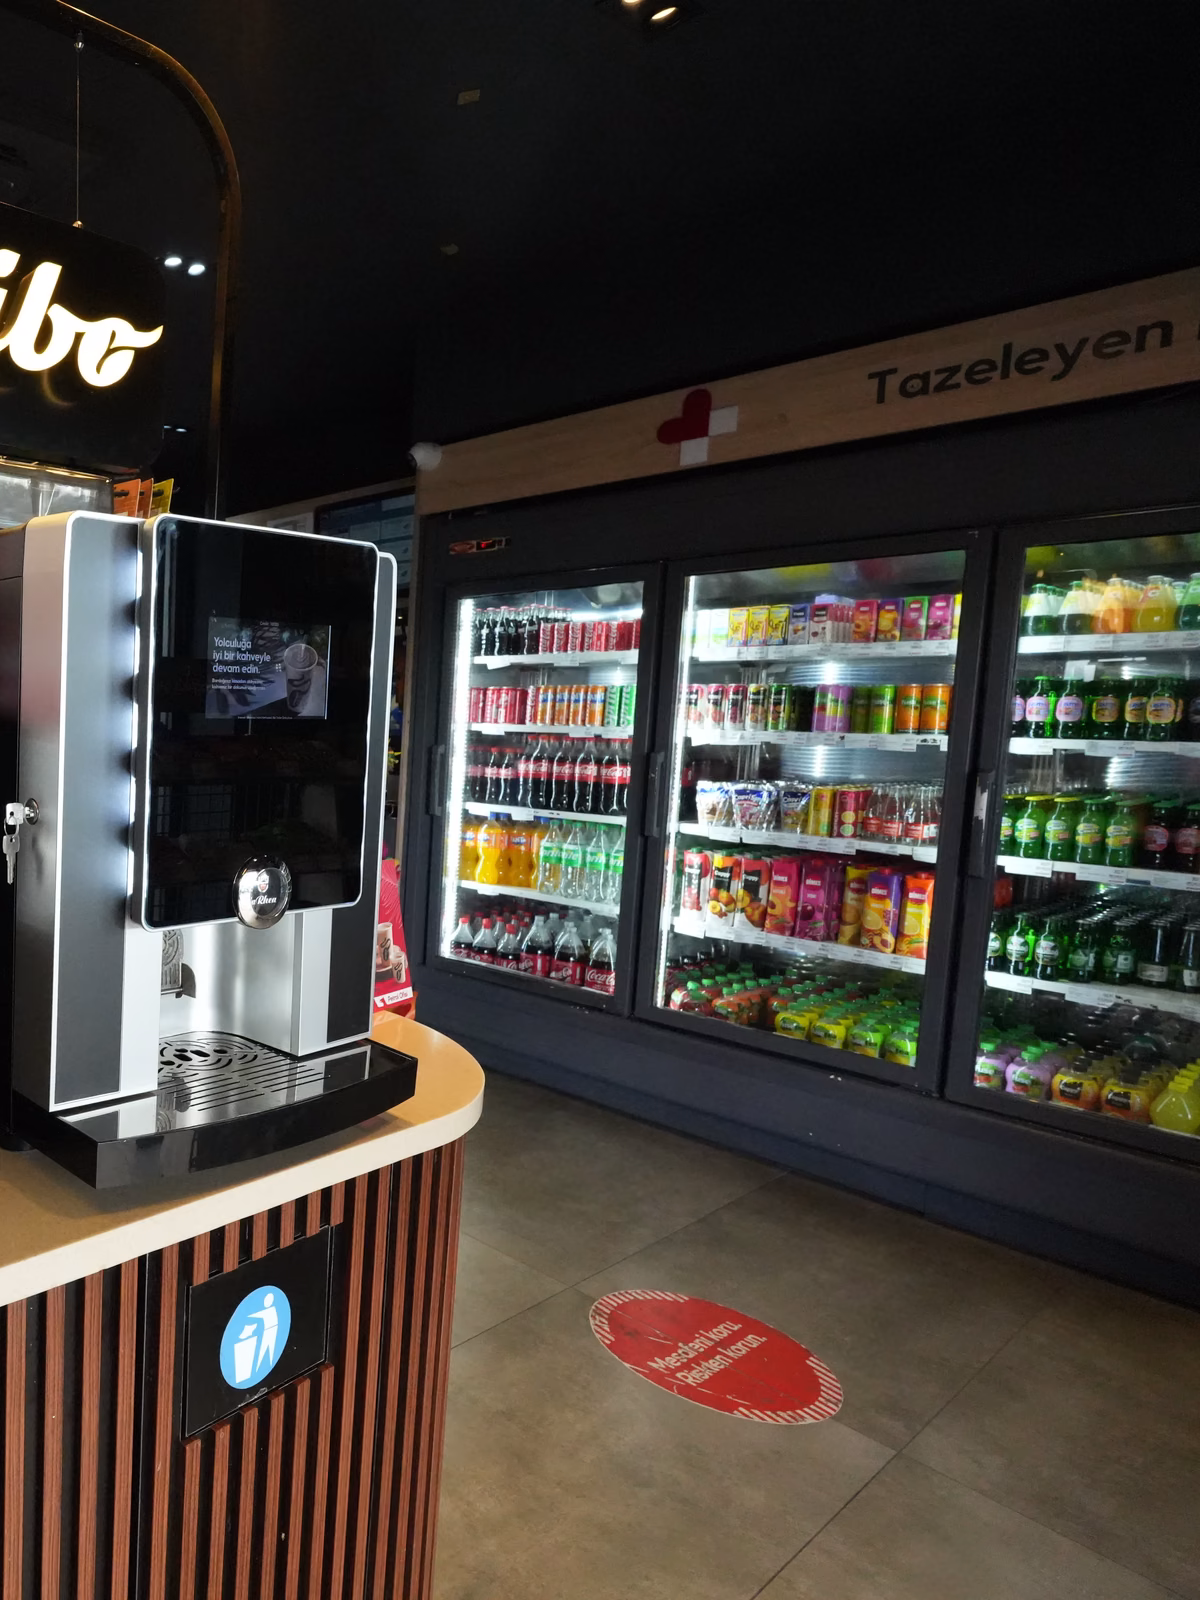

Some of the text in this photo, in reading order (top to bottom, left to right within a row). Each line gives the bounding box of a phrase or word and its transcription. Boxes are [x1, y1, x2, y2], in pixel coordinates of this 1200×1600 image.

[868, 320, 1173, 404] Tazeleyen
[213, 650, 271, 664] iyi bir kahveyle
[214, 637, 252, 651] Yolculuğa
[212, 664, 261, 674] devam edin.
[647, 1321, 742, 1374] Mesafeni koru.
[675, 1333, 767, 1387] Riskten korun.
